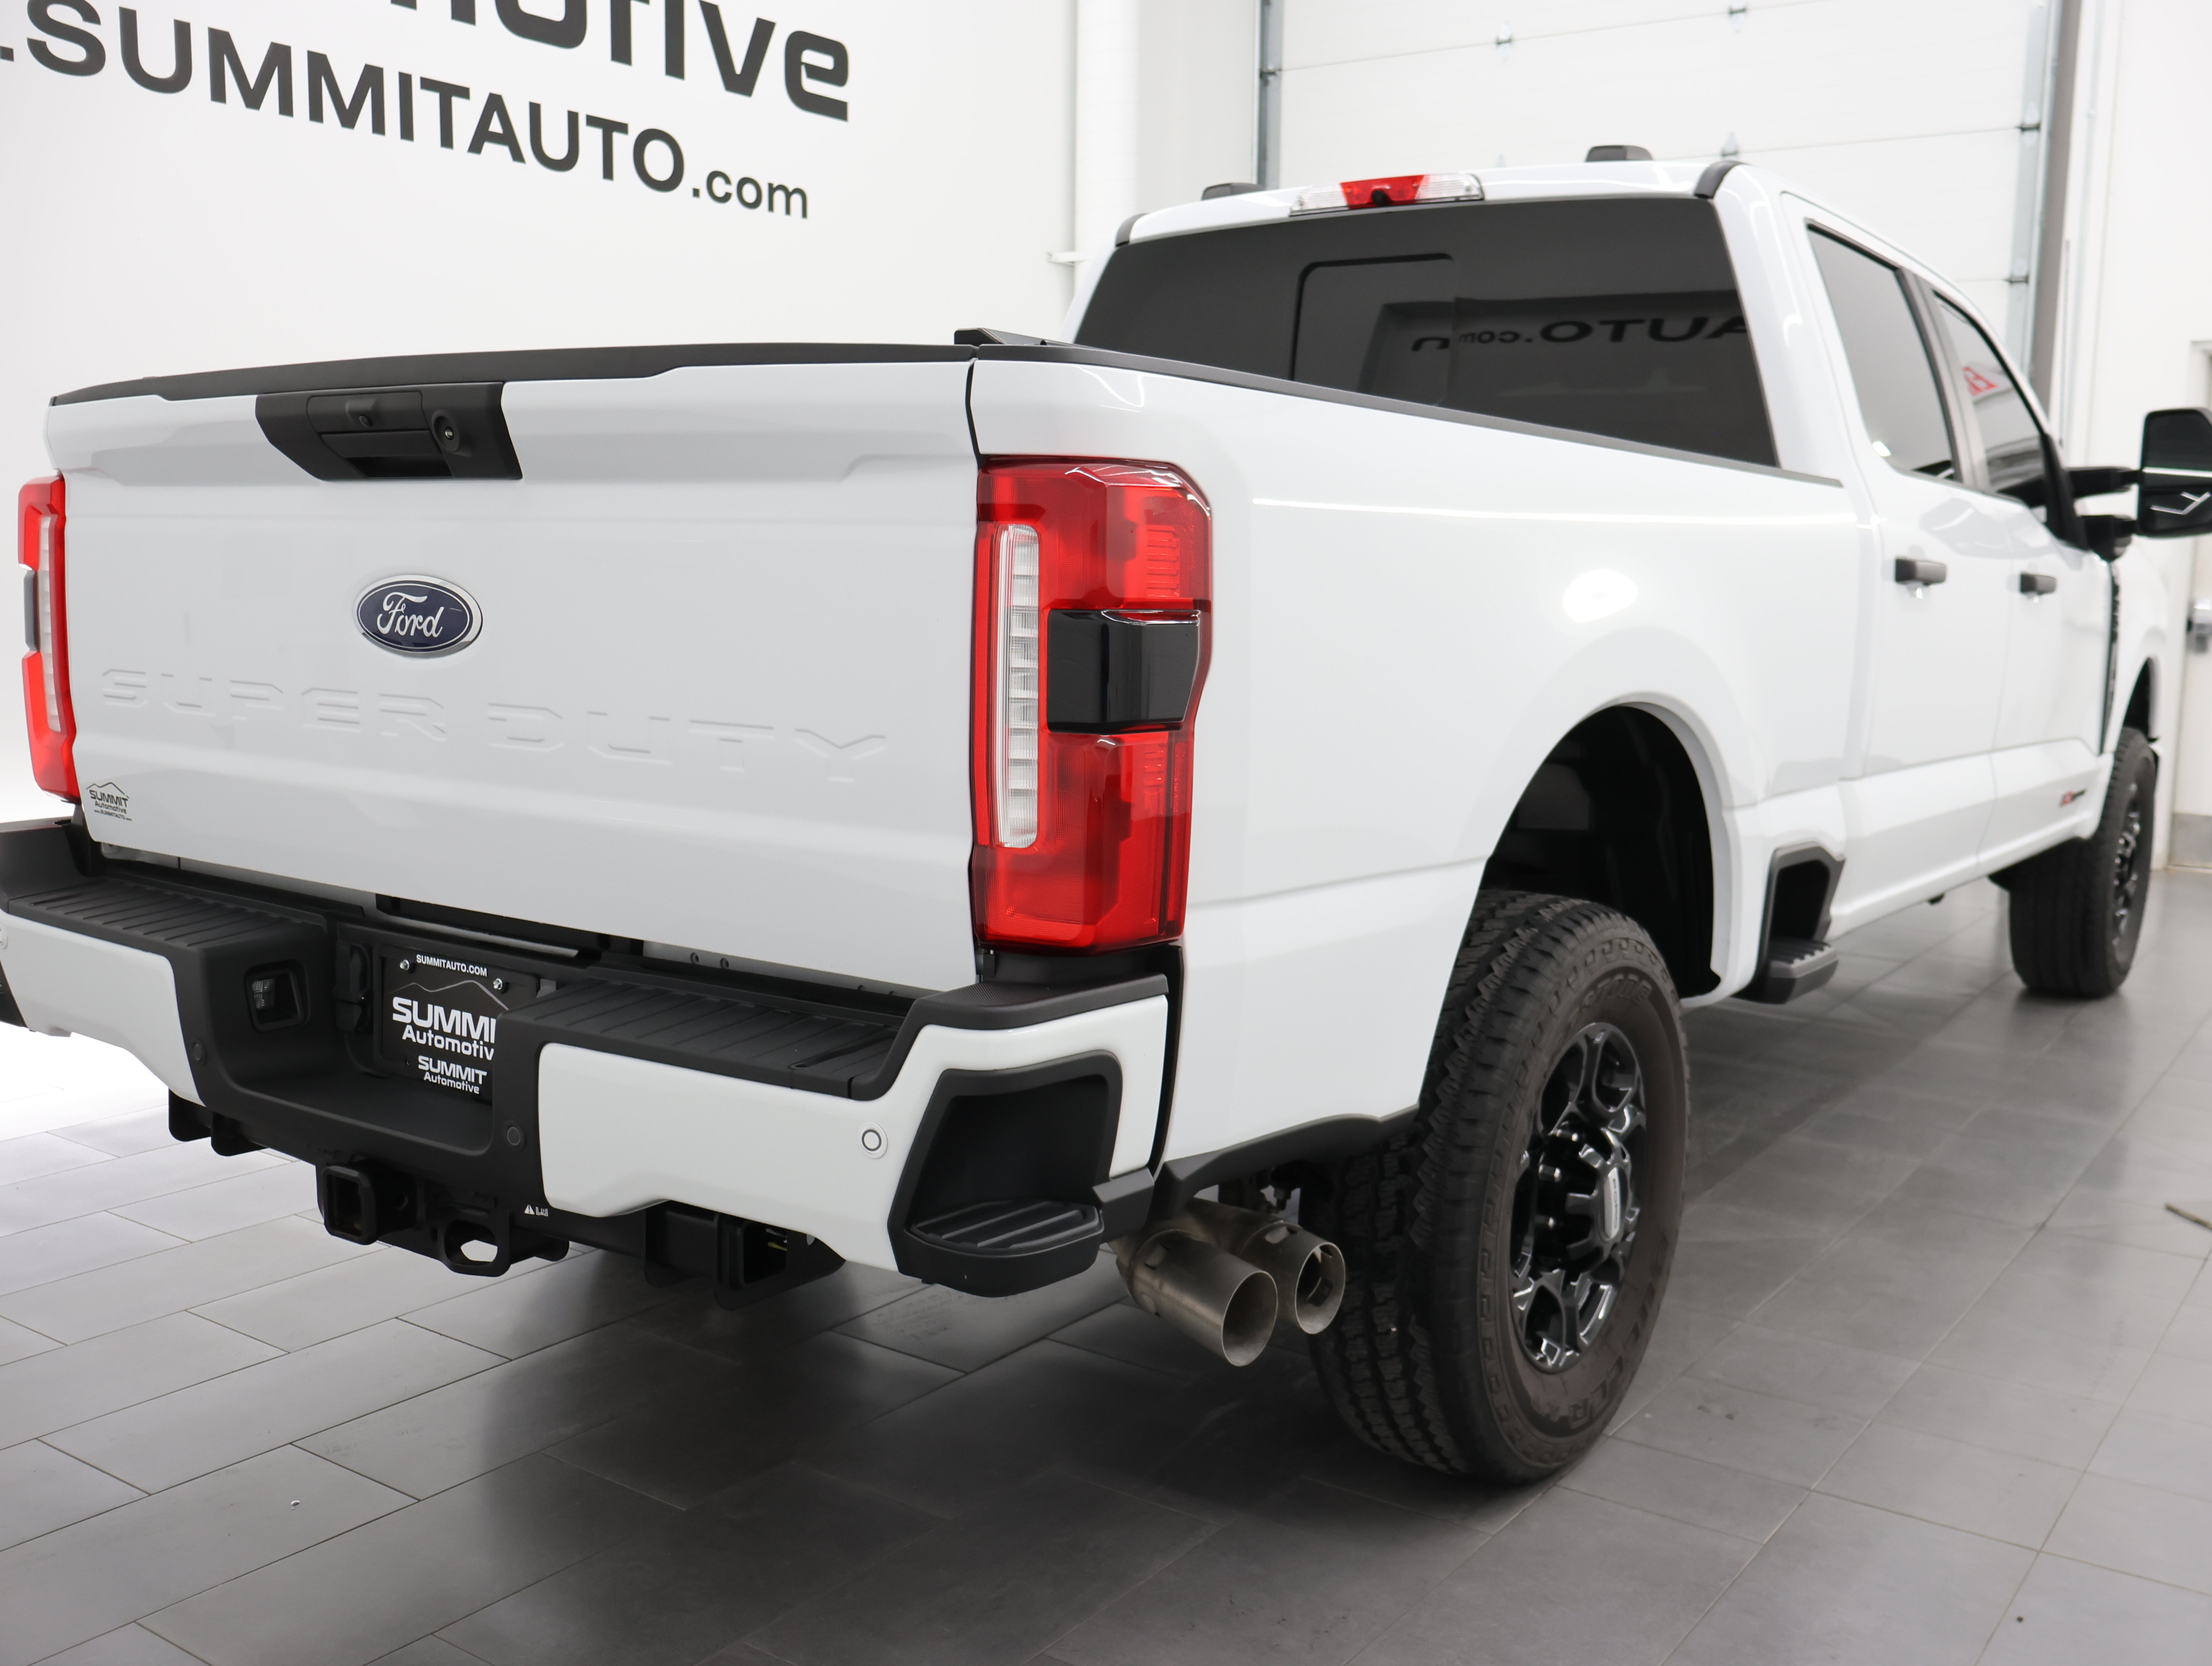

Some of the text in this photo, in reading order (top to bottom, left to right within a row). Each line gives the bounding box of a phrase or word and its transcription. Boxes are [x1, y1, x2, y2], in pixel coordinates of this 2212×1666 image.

[376, 592, 444, 638] Ford
[102, 668, 887, 784] SUPER DUTY
[89, 789, 128, 807] SUMMIT
[95, 801, 127, 814] Automotive
[416, 954, 487, 977] SUMMITAUTO.COM
[393, 996, 496, 1044] SUMMI
[402, 1025, 494, 1061] Automotiv
[418, 1055, 488, 1084] SUMMIT
[424, 1072, 479, 1094] Automotive
